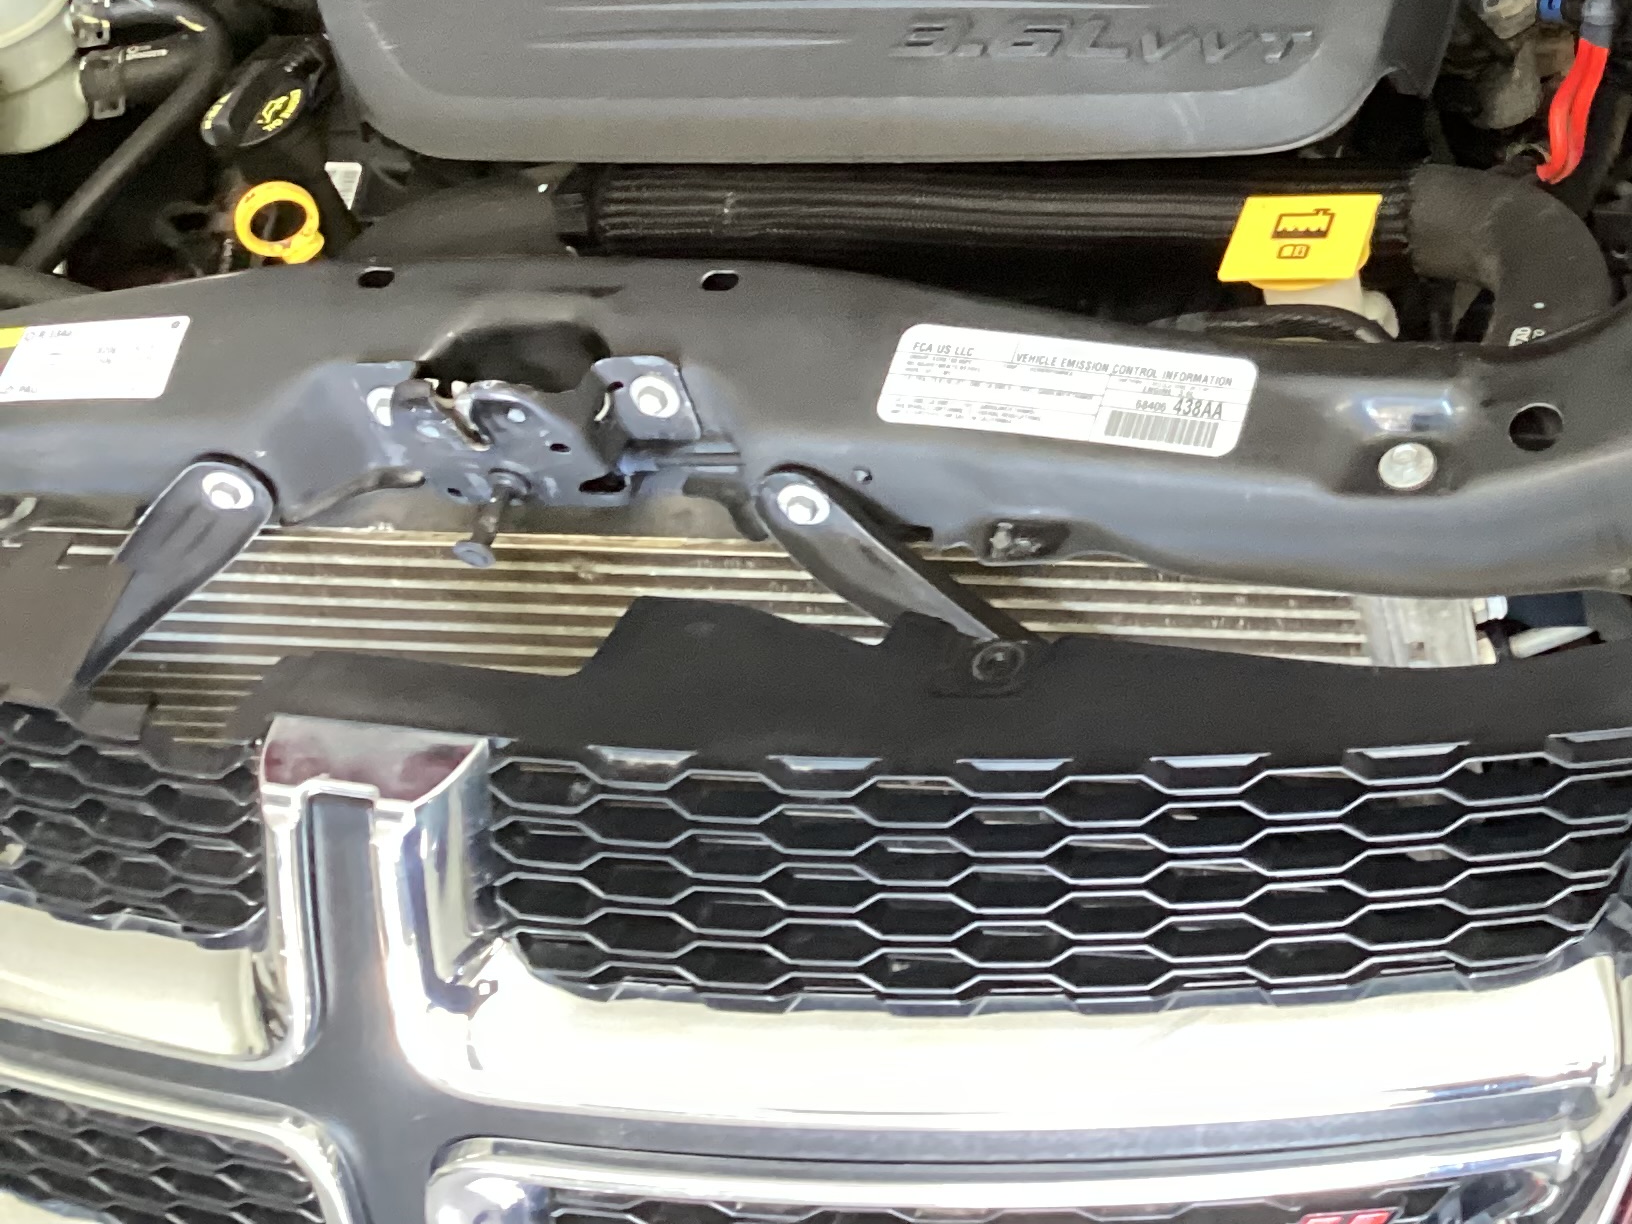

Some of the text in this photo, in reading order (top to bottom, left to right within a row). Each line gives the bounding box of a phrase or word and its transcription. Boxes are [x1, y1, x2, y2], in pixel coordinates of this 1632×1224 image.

[912, 341, 974, 357] FCA US LLC
[1015, 352, 1057, 367] VEHICLE
[1060, 358, 1110, 373] EMISSION
[1112, 363, 1158, 379] CONTROL
[1162, 370, 1233, 386] INFORMATION
[1172, 396, 1223, 420] 438AA
